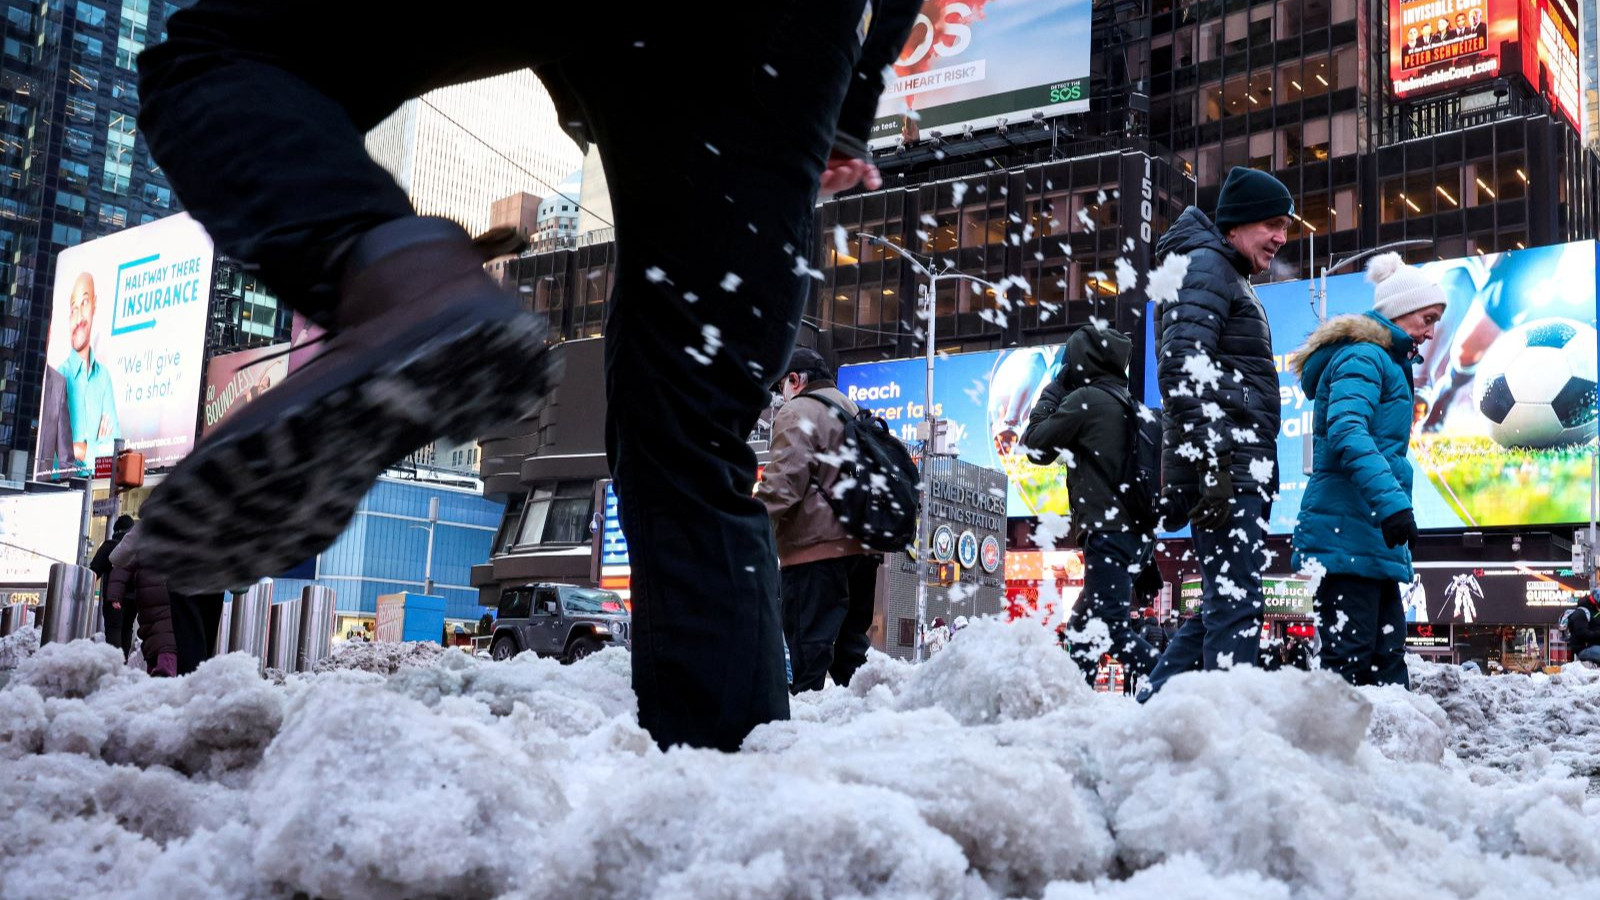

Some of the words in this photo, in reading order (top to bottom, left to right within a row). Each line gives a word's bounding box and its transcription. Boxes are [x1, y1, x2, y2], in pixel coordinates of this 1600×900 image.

[1403, 0, 1453, 26] INVISIBLE
[895, 2, 971, 67] OS
[1404, 50, 1431, 68] PETER
[1434, 37, 1485, 60] SCHWEIZER
[905, 73, 942, 91] HEART
[944, 66, 977, 83] RISK?
[1050, 82, 1070, 90] DETECT
[1393, 59, 1497, 93] TheInvisibleCoup.com
[1050, 86, 1080, 102] SOS
[881, 121, 898, 131] test.
[1141, 157, 1152, 244] 1500
[125, 265, 168, 291] HALFWAY
[172, 257, 200, 279] THERE
[122, 279, 199, 318] INSURANCE
[156, 347, 181, 376] give
[125, 383, 132, 403] it
[135, 387, 143, 401] a
[206, 368, 255, 426] BOUNDLESS
[207, 385, 216, 401] GO
[848, 381, 900, 401] Reach
[907, 401, 943, 419] fas
[965, 489, 1006, 515] FORCES
[965, 510, 1001, 531] STATION
[10, 592, 40, 605] GIFTS
[1262, 586, 1309, 597] TABUCK
[1264, 597, 1304, 607] COFFEE
[1526, 590, 1572, 601] GUNDAM
